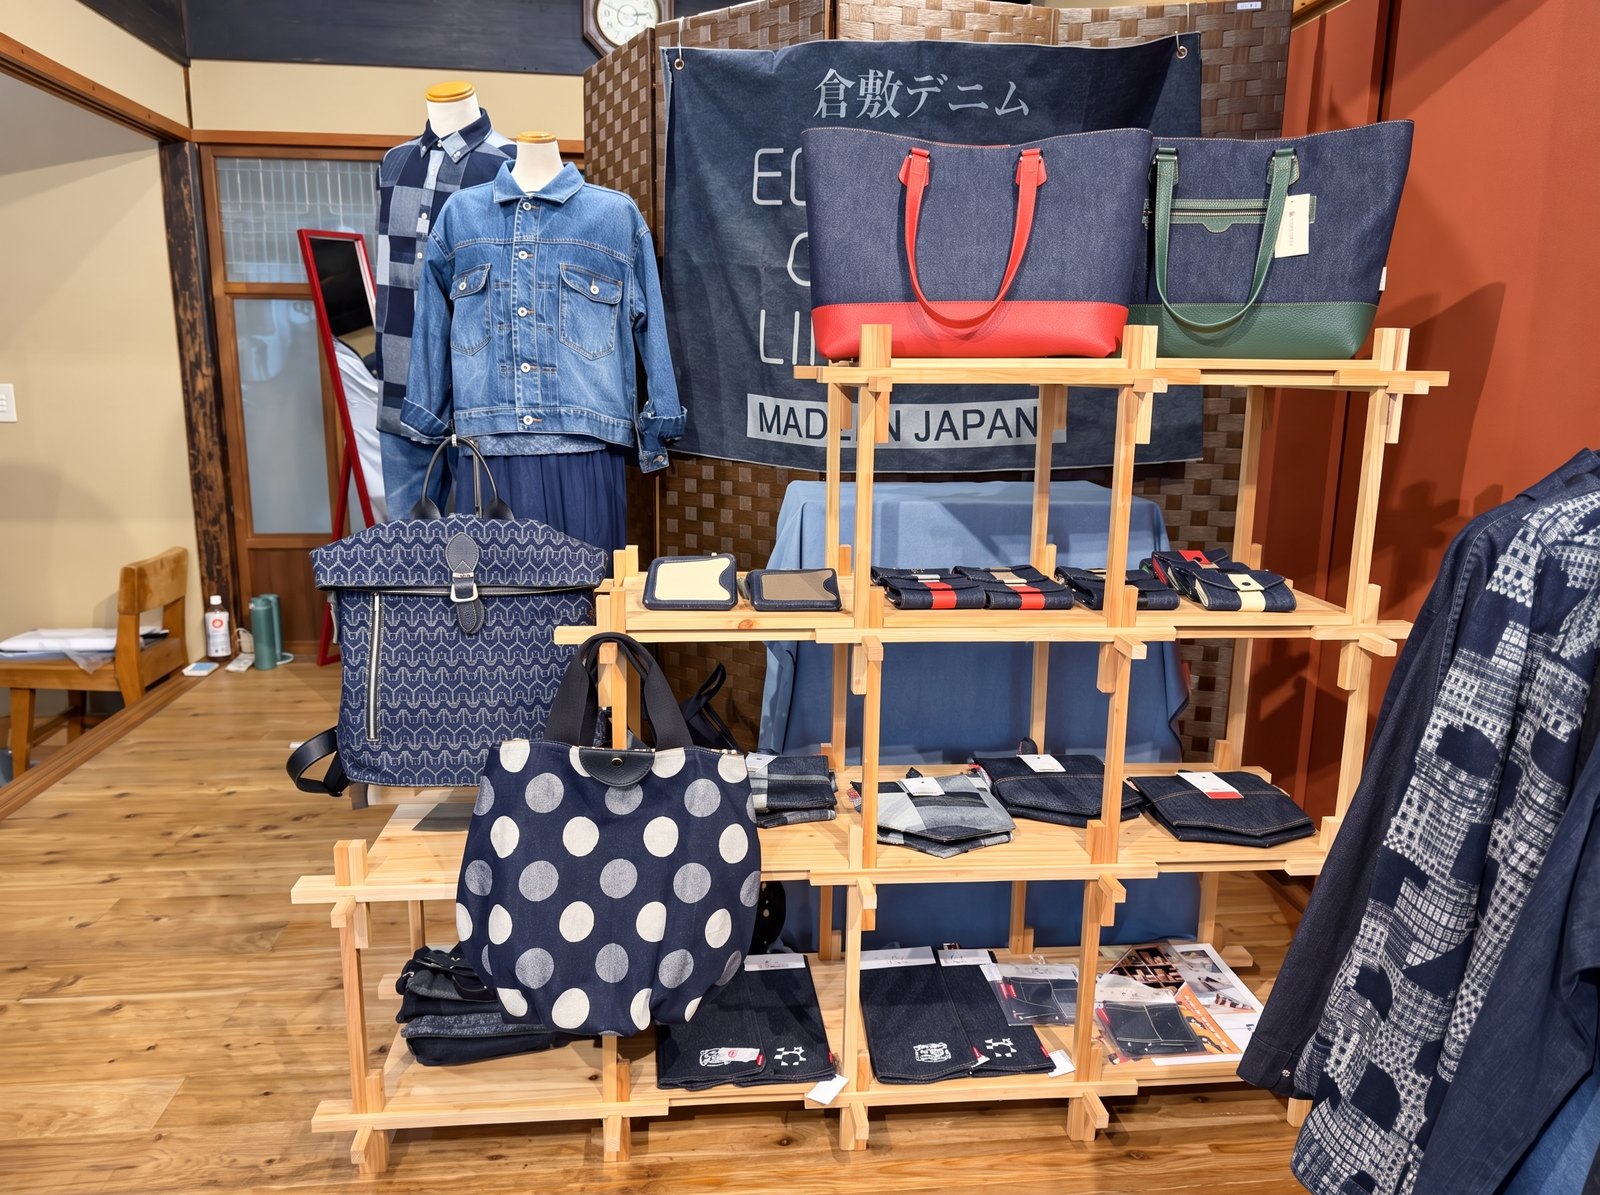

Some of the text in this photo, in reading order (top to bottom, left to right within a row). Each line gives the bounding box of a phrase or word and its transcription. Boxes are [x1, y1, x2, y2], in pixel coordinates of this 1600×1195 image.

[813, 68, 1029, 119] 倉敷デニム
[760, 309, 815, 366] LI
[914, 406, 1037, 442] JAPAN
